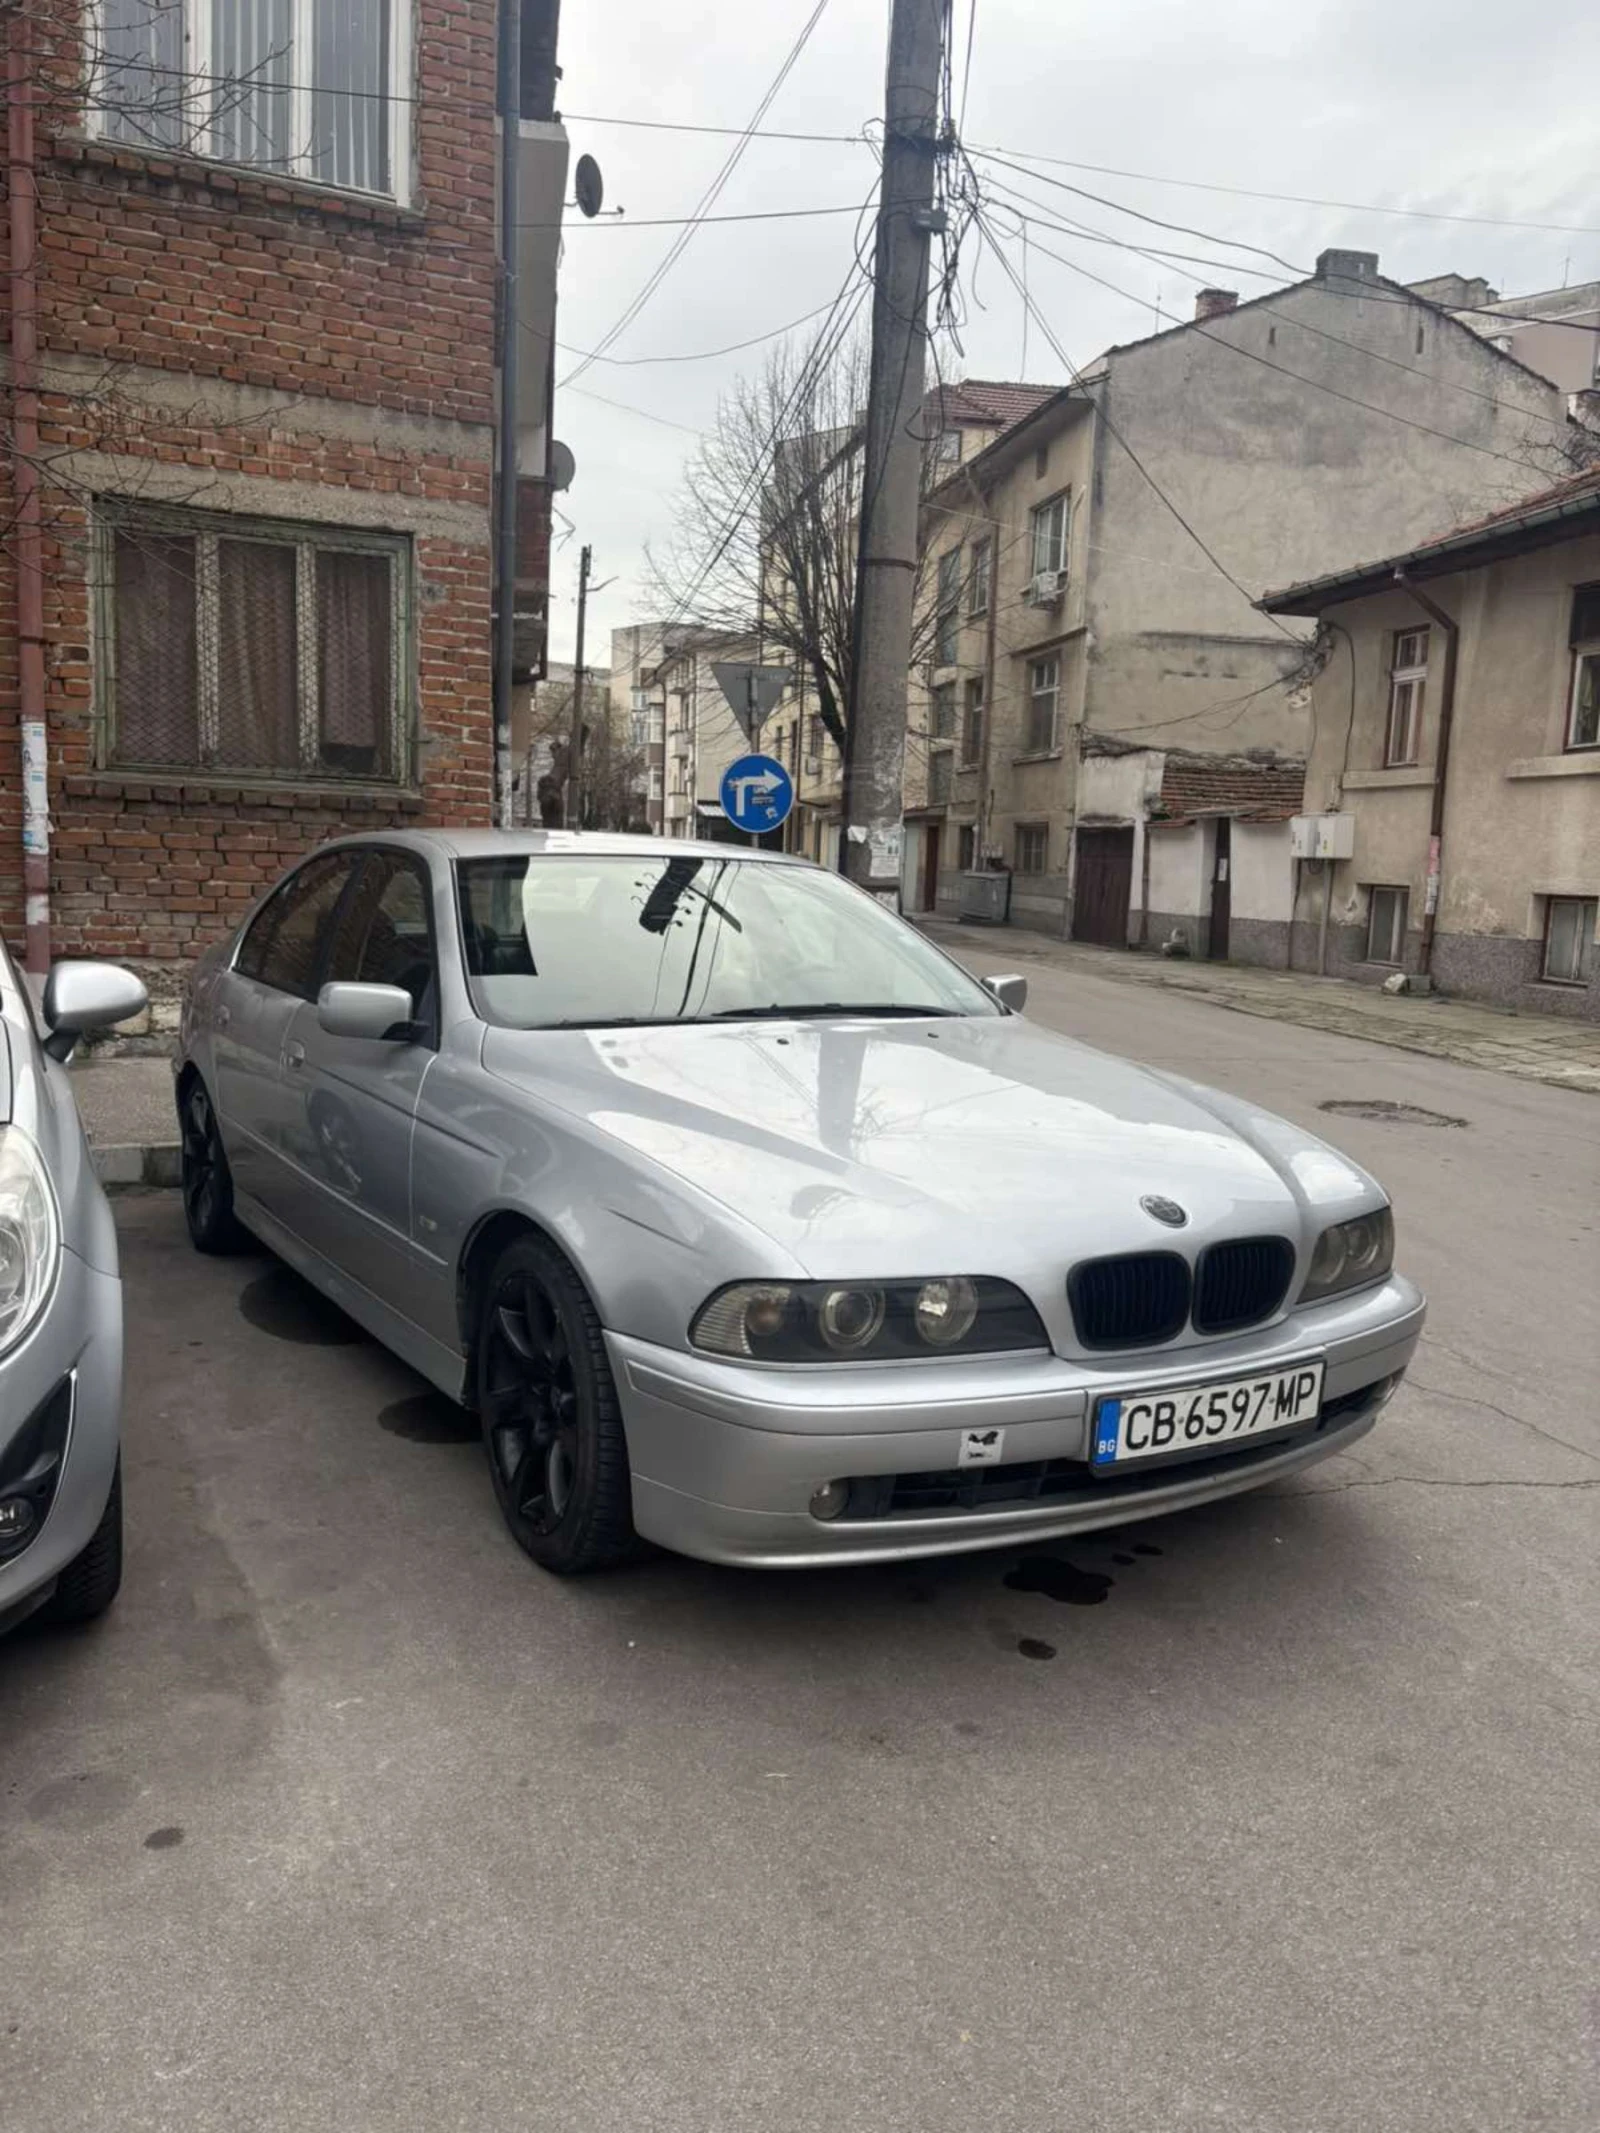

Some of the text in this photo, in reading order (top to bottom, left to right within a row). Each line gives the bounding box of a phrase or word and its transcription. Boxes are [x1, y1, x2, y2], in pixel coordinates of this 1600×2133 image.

[1184, 1381, 1271, 1440] 6597
[1273, 1371, 1316, 1421] MP
[1098, 1439, 1116, 1455] BG
